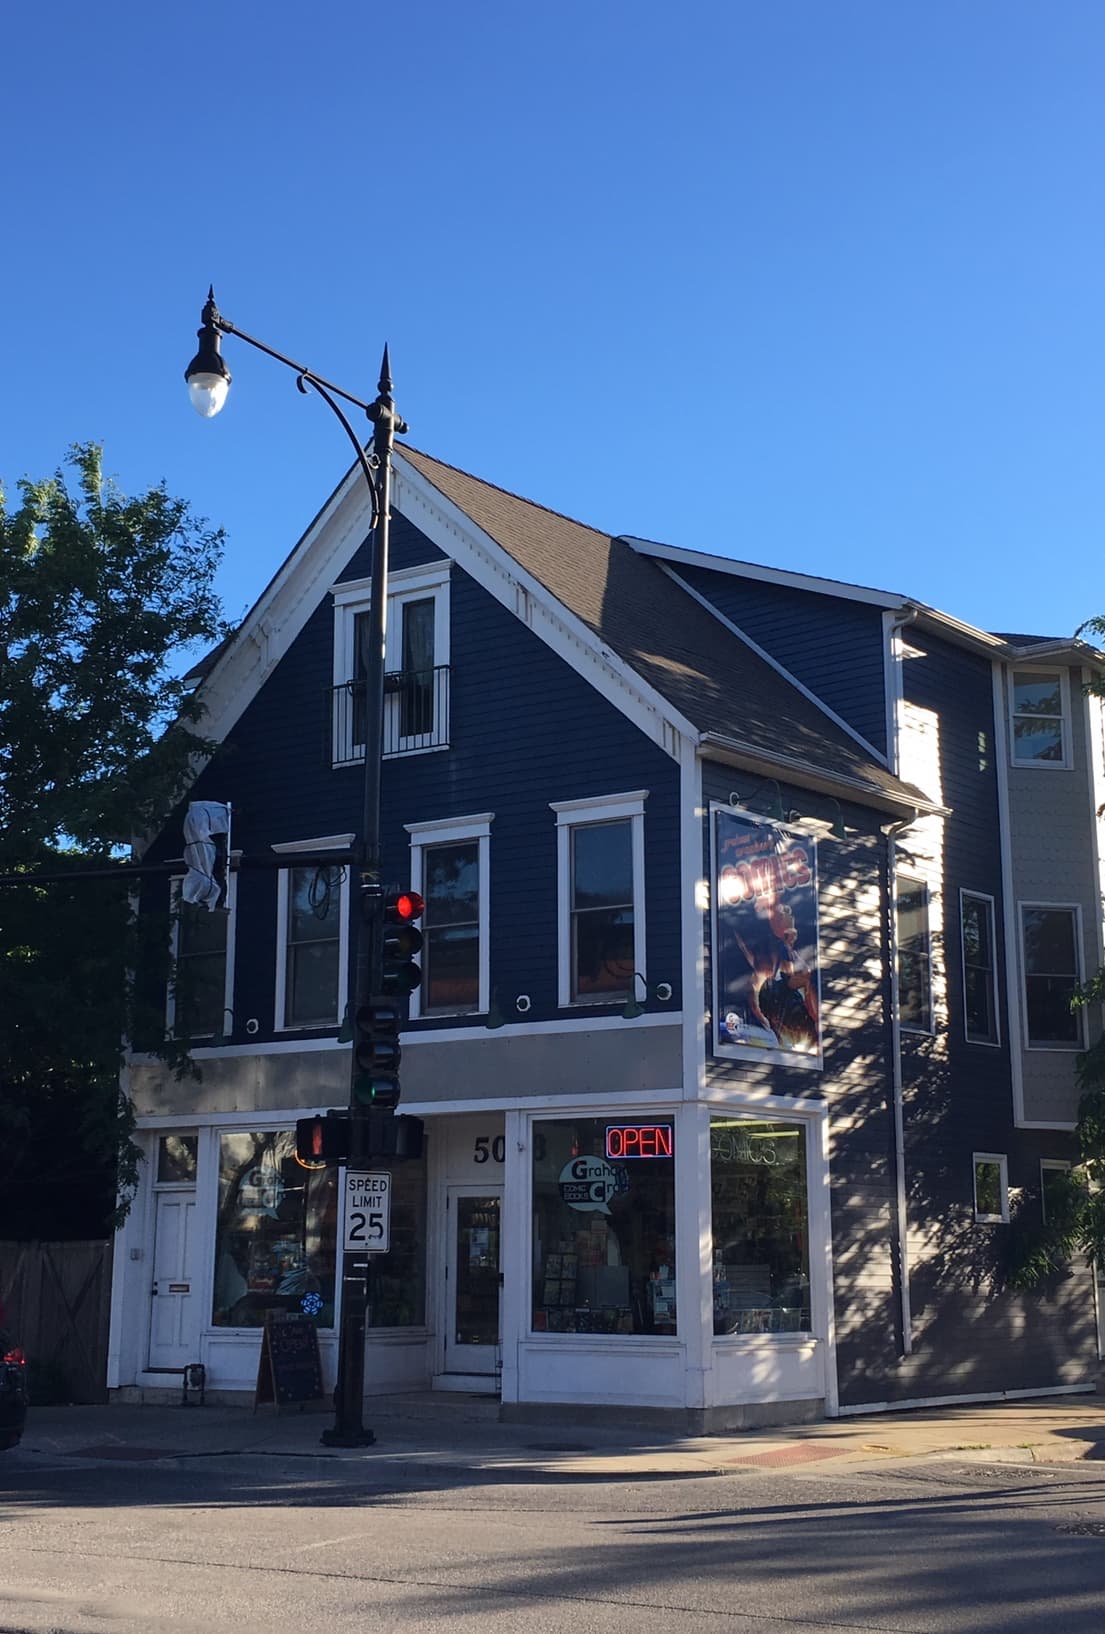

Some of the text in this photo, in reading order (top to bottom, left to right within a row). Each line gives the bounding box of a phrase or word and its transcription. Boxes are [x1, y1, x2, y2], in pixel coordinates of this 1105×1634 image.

[721, 847, 811, 904] COMICS
[608, 1128, 673, 1156] OPEN
[349, 1179, 387, 1192] SPEED
[352, 1196, 382, 1208] LIMIT
[349, 1213, 384, 1240] 25
